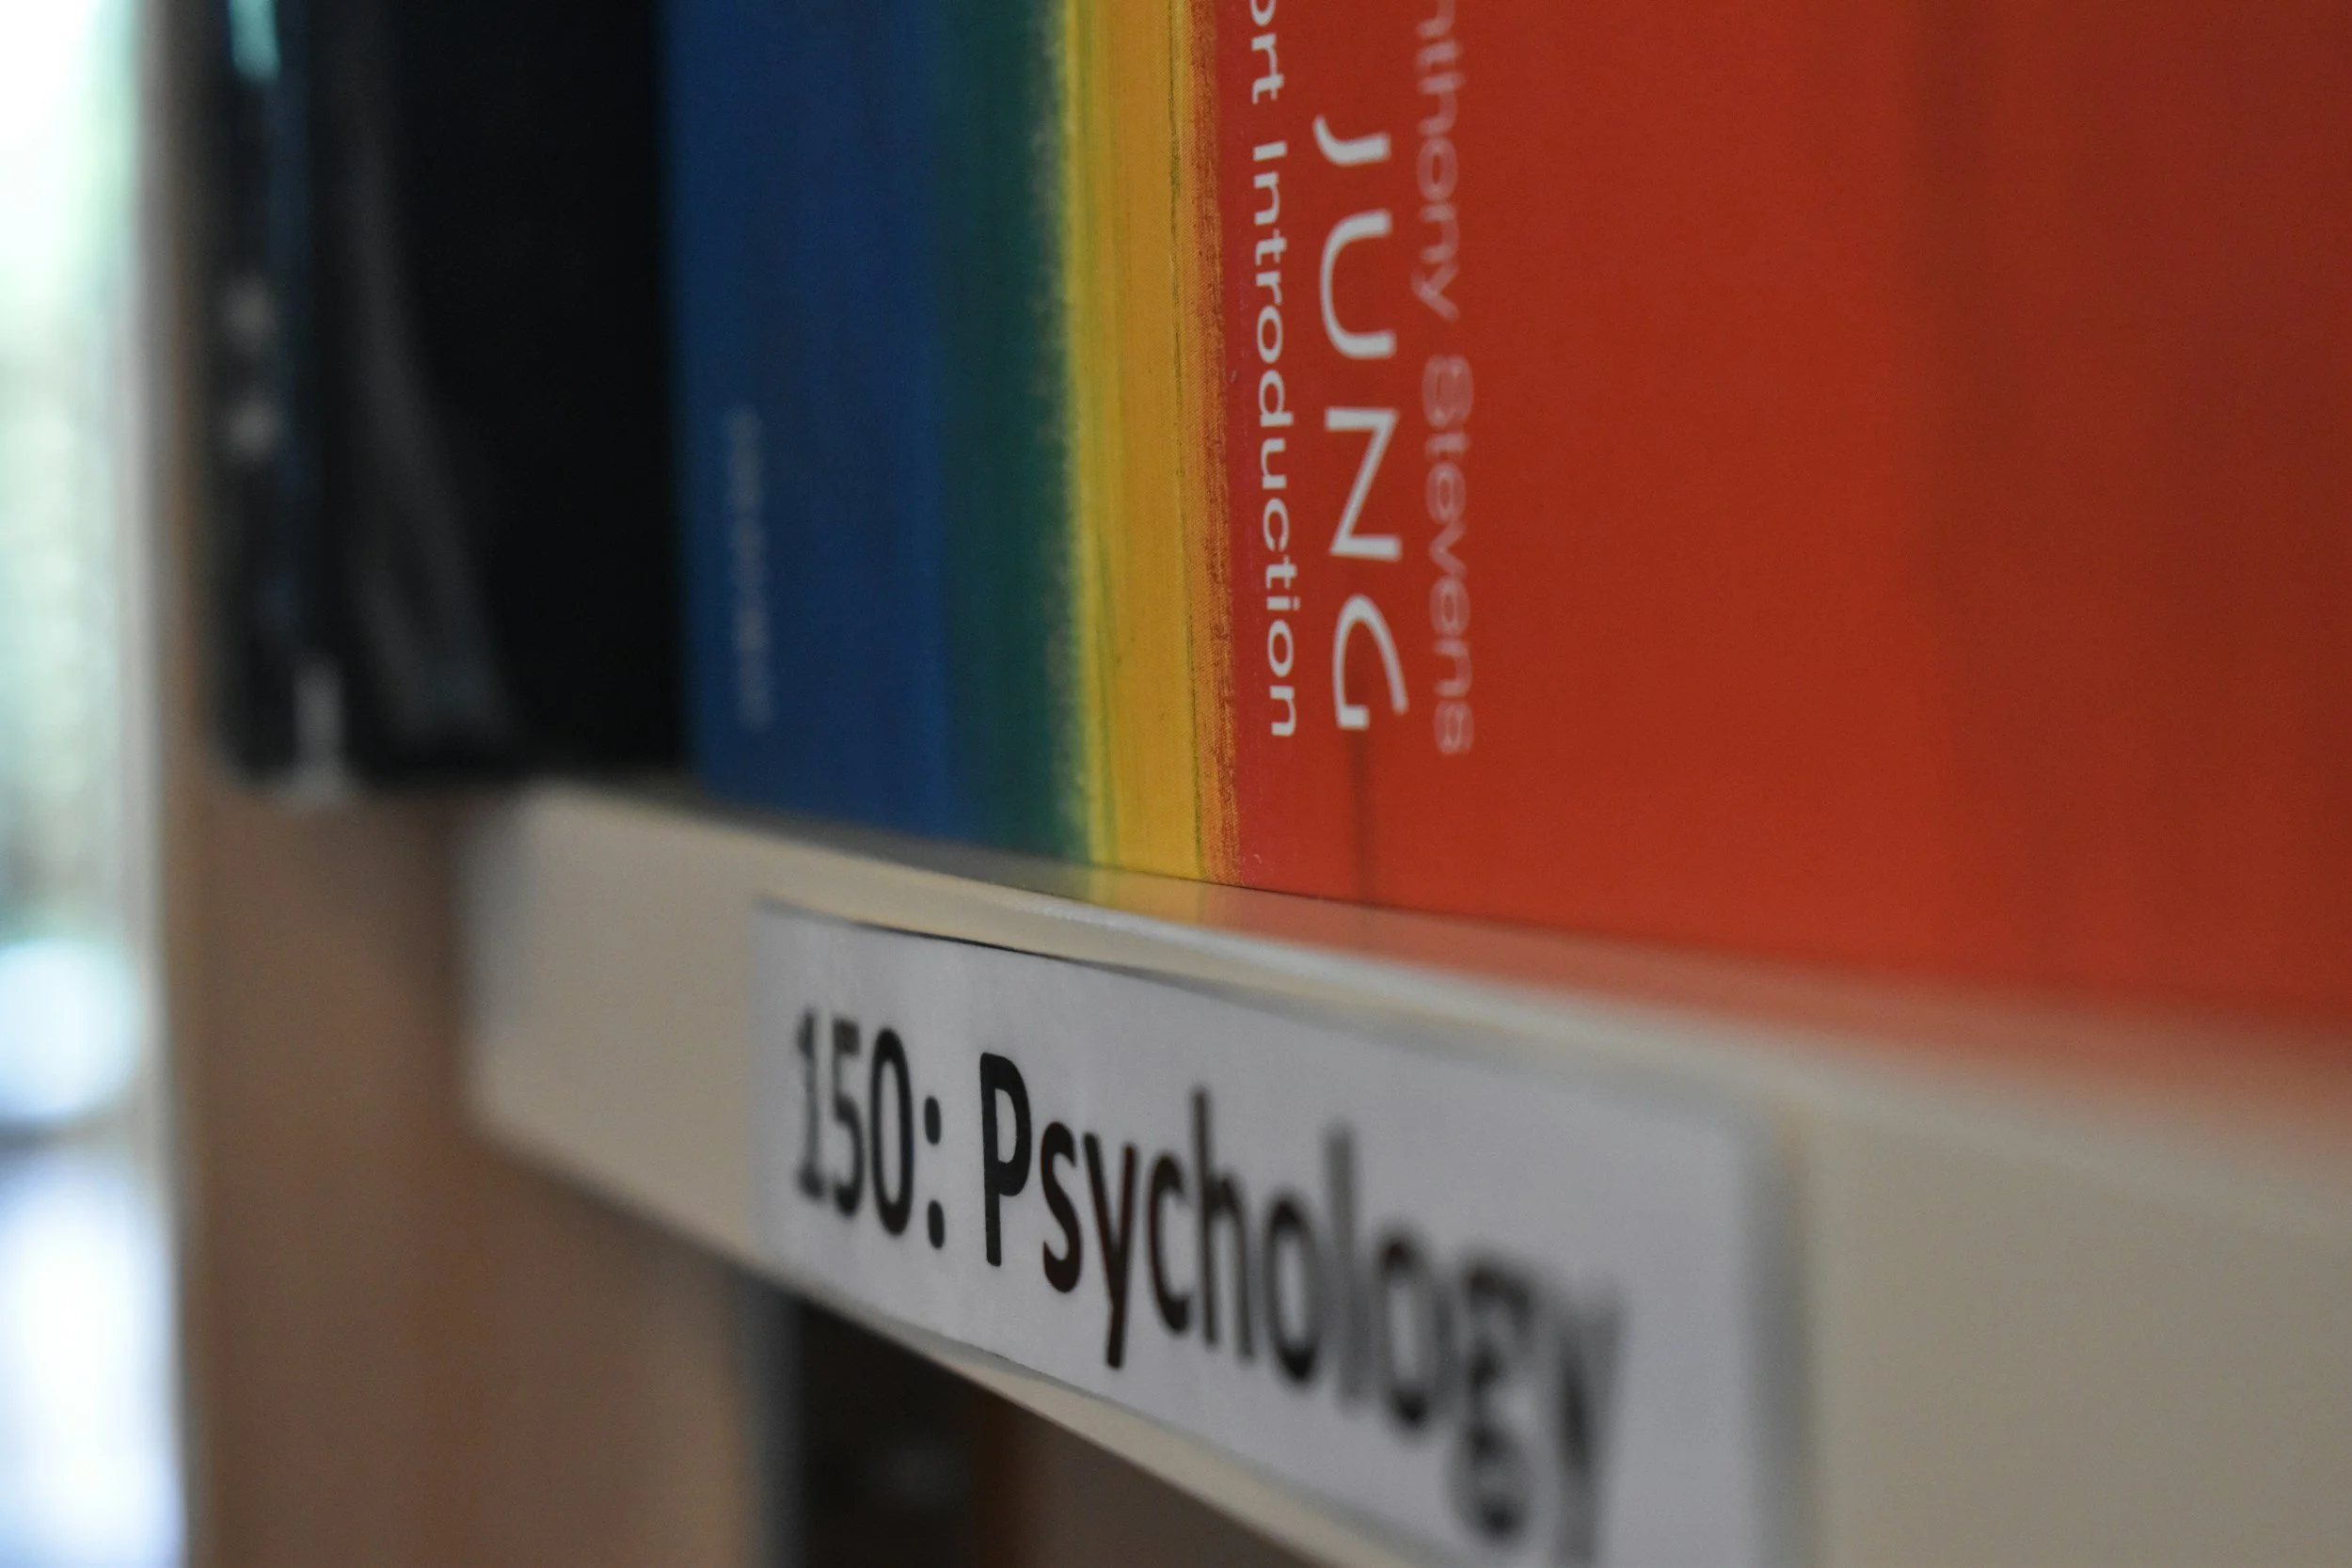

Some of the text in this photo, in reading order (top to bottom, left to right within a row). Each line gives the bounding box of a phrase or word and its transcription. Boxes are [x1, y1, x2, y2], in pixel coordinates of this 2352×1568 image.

[1253, 141, 1300, 736] Introduction
[1313, 114, 1409, 729] JUNG
[1422, 355, 1474, 753] Stevens
[797, 1005, 1626, 1568] 150: Psychology
